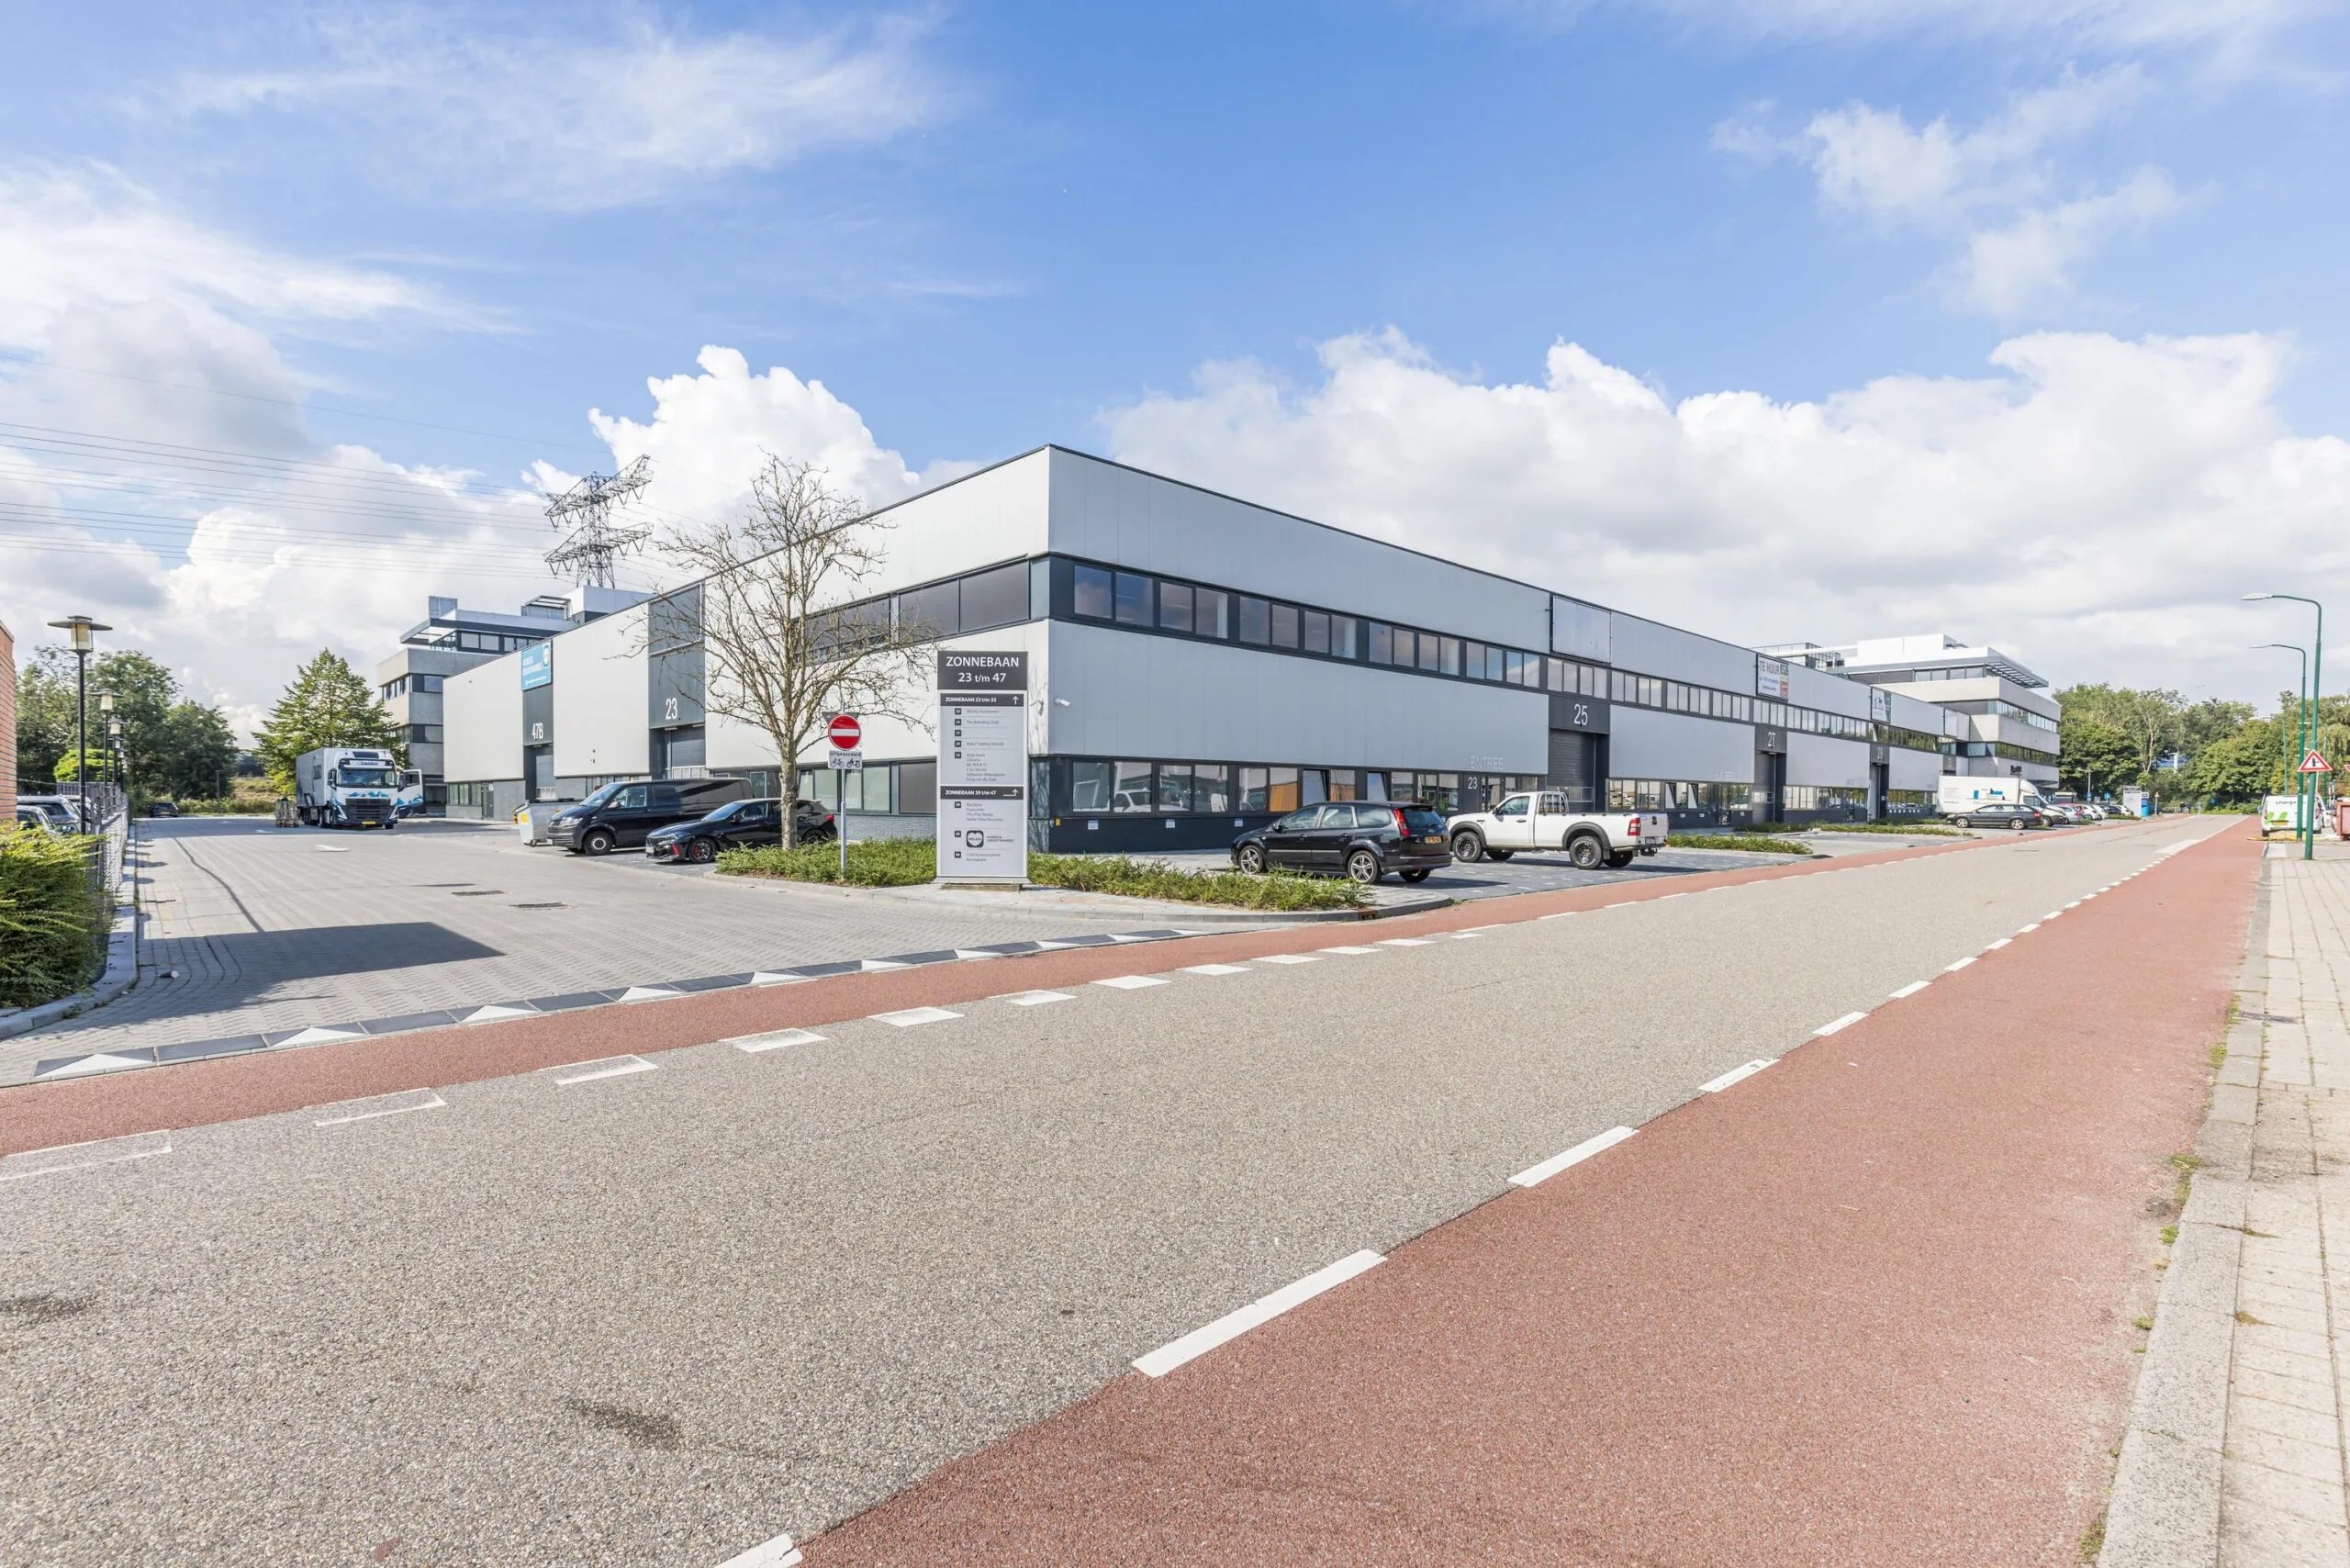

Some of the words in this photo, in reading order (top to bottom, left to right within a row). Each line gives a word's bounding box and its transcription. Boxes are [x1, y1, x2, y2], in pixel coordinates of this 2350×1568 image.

[946, 656, 1019, 666] ZONNEBAAN
[958, 672, 971, 682] 23
[975, 674, 990, 682] t/m
[992, 673, 1006, 682] 47
[666, 698, 677, 720] 23
[1573, 703, 1588, 725] 25
[532, 722, 543, 739] 47B
[1768, 732, 1775, 747] 27
[1470, 756, 1504, 770] ENTREE
[1468, 777, 1478, 789] 23
